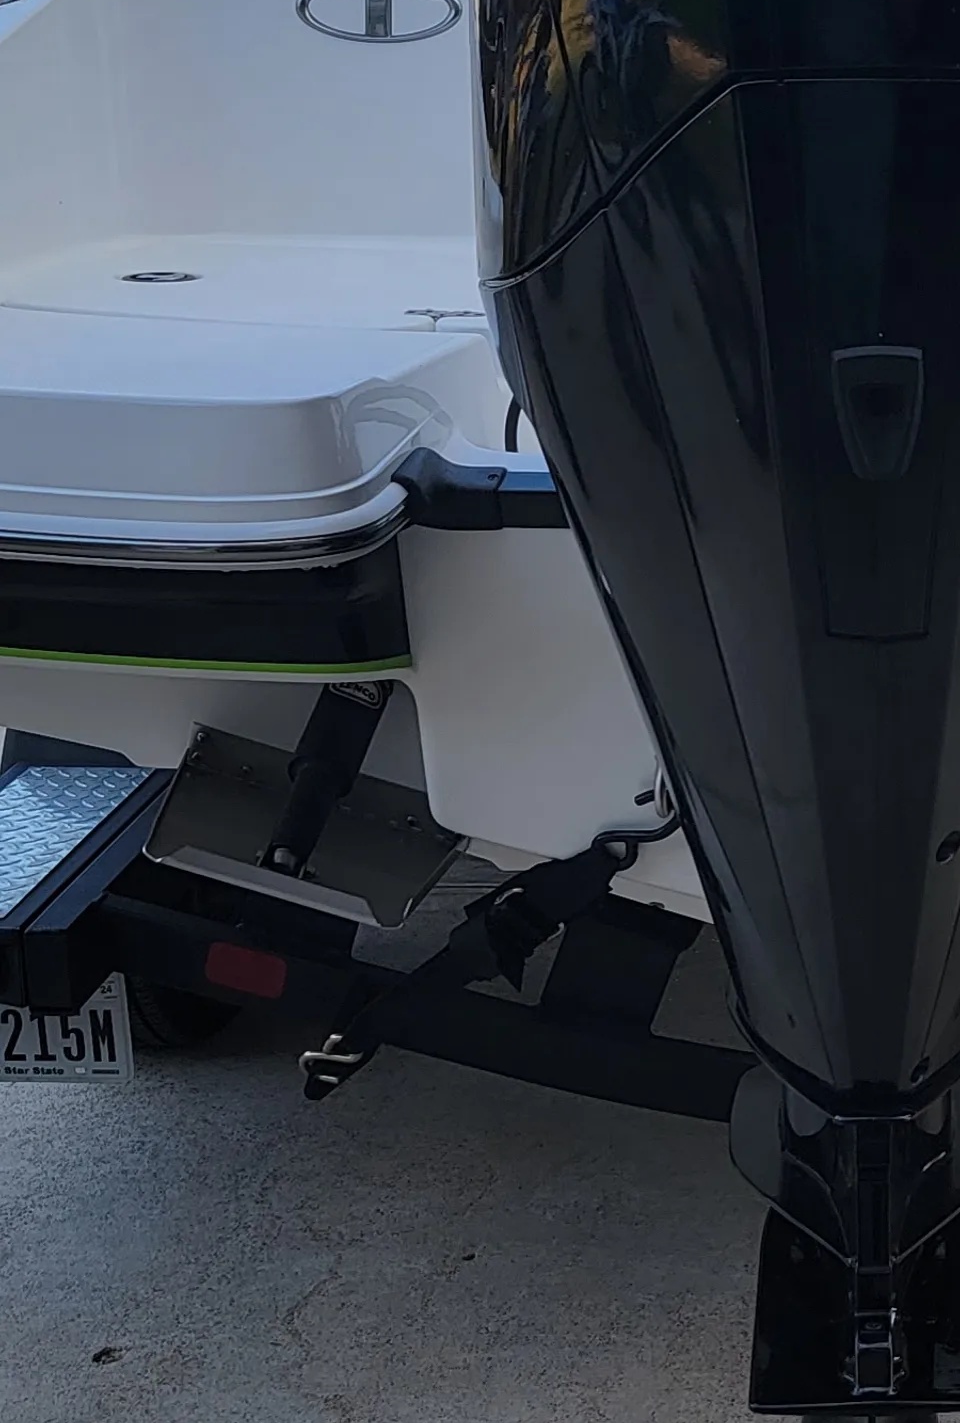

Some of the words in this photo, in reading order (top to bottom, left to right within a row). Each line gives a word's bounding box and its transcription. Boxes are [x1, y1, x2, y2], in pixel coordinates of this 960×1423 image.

[100, 985, 112, 994] 24
[4, 1066, 29, 1075] Star
[33, 1066, 65, 1076] State
